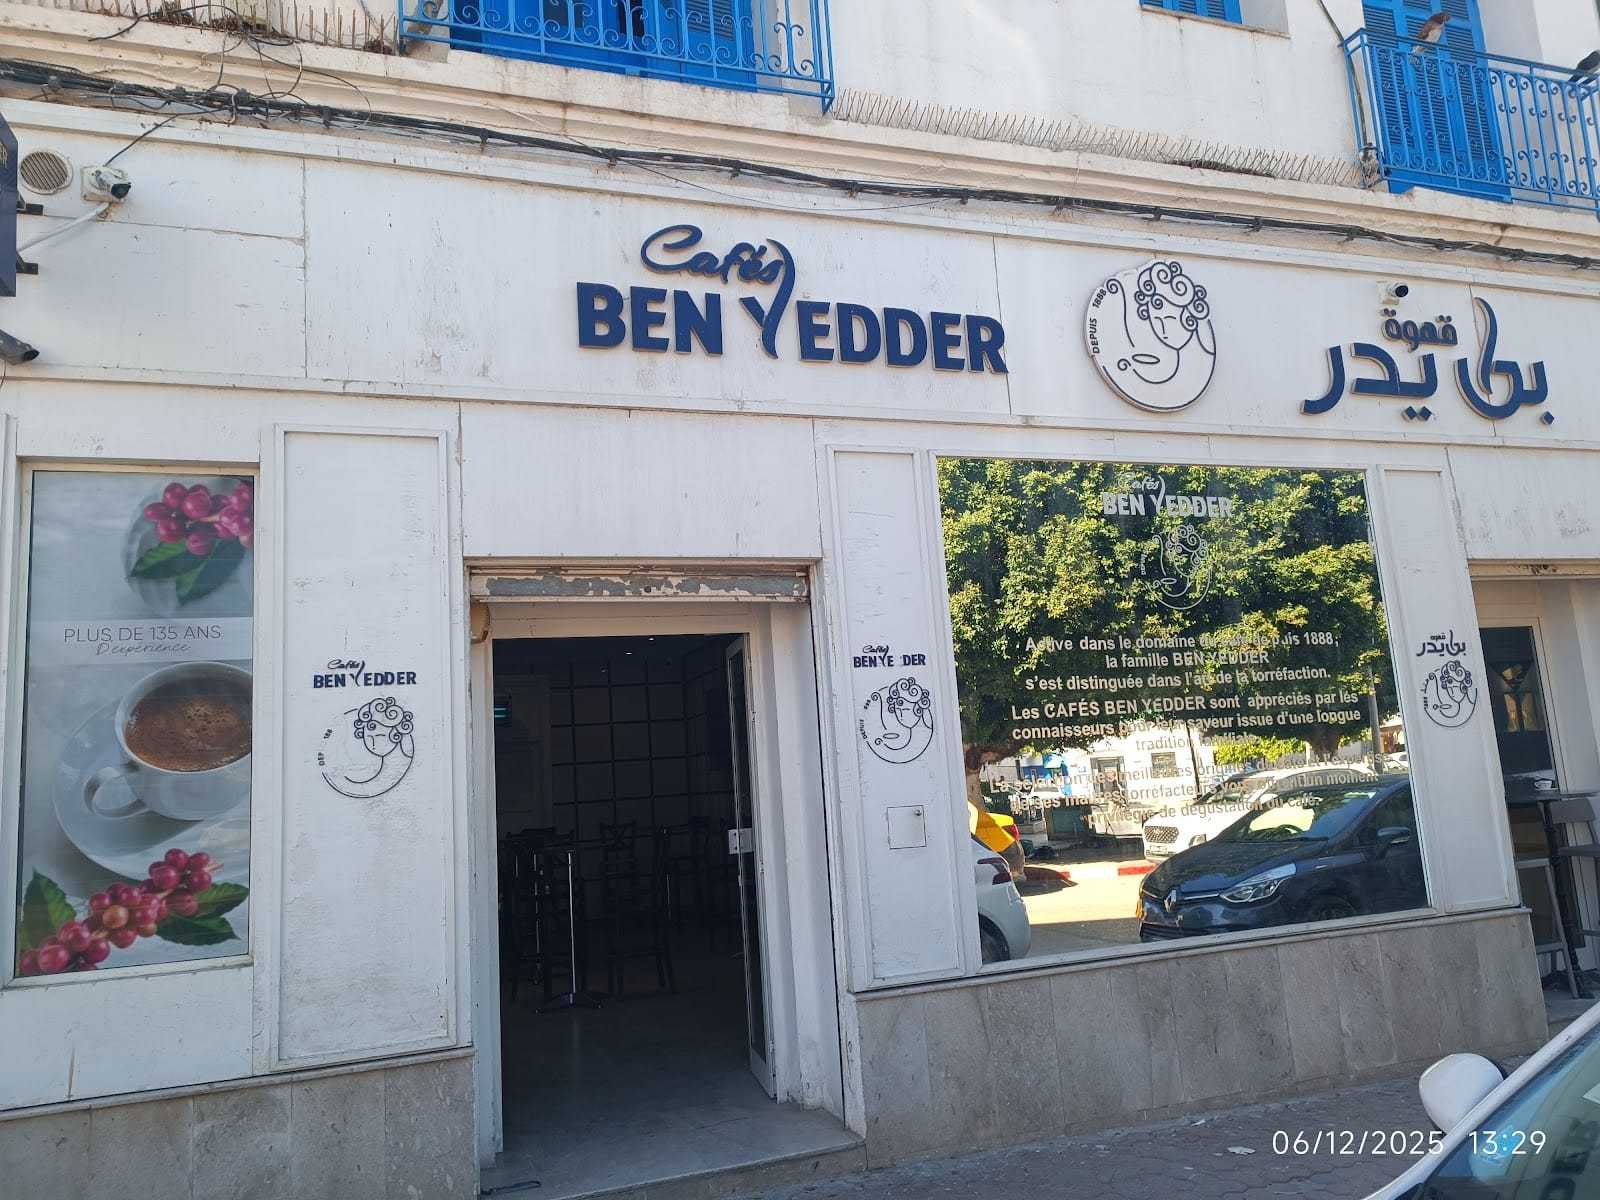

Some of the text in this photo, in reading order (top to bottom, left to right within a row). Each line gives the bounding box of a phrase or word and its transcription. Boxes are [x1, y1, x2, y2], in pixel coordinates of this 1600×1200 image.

[640, 224, 784, 284] Cafés
[577, 239, 1009, 374] BEN YEDDER
[1089, 288, 1107, 354] DEPUIS 1888
[1380, 307, 1458, 353] قهوة
[1300, 342, 1438, 422] يدر
[1118, 472, 1160, 491] Cafés
[1103, 475, 1234, 518] BEN YEDDER
[64, 625, 221, 642] PLUS DE 135 ANS
[1079, 636, 1115, 651] dans
[1118, 635, 1132, 650] le
[1136, 634, 1196, 649] domaine
[1303, 631, 1340, 647] 1888,
[853, 655, 877, 668] BEN
[1105, 650, 1269, 668] la famille BEN YEDDER
[1416, 642, 1444, 657] يدر
[313, 660, 417, 688] BEN YEDDER
[1066, 674, 1143, 692] distinguée
[1147, 674, 1182, 688] dans
[1216, 671, 1232, 684] de
[1236, 669, 1249, 682] la
[1251, 666, 1331, 682] torréfaction.
[1012, 690, 1358, 720] Les CAFÉS BEN YEDDER sont appréciés par les
[1012, 722, 1114, 740] connaisseurs
[1237, 713, 1273, 727] issue
[1316, 708, 1361, 725] longue
[989, 778, 1009, 793] La
[1327, 772, 1378, 786] moment
[1159, 804, 1176, 818] de
[1181, 798, 1263, 818] dégustation
[1268, 797, 1284, 808] du
[1288, 791, 1320, 808] café.
